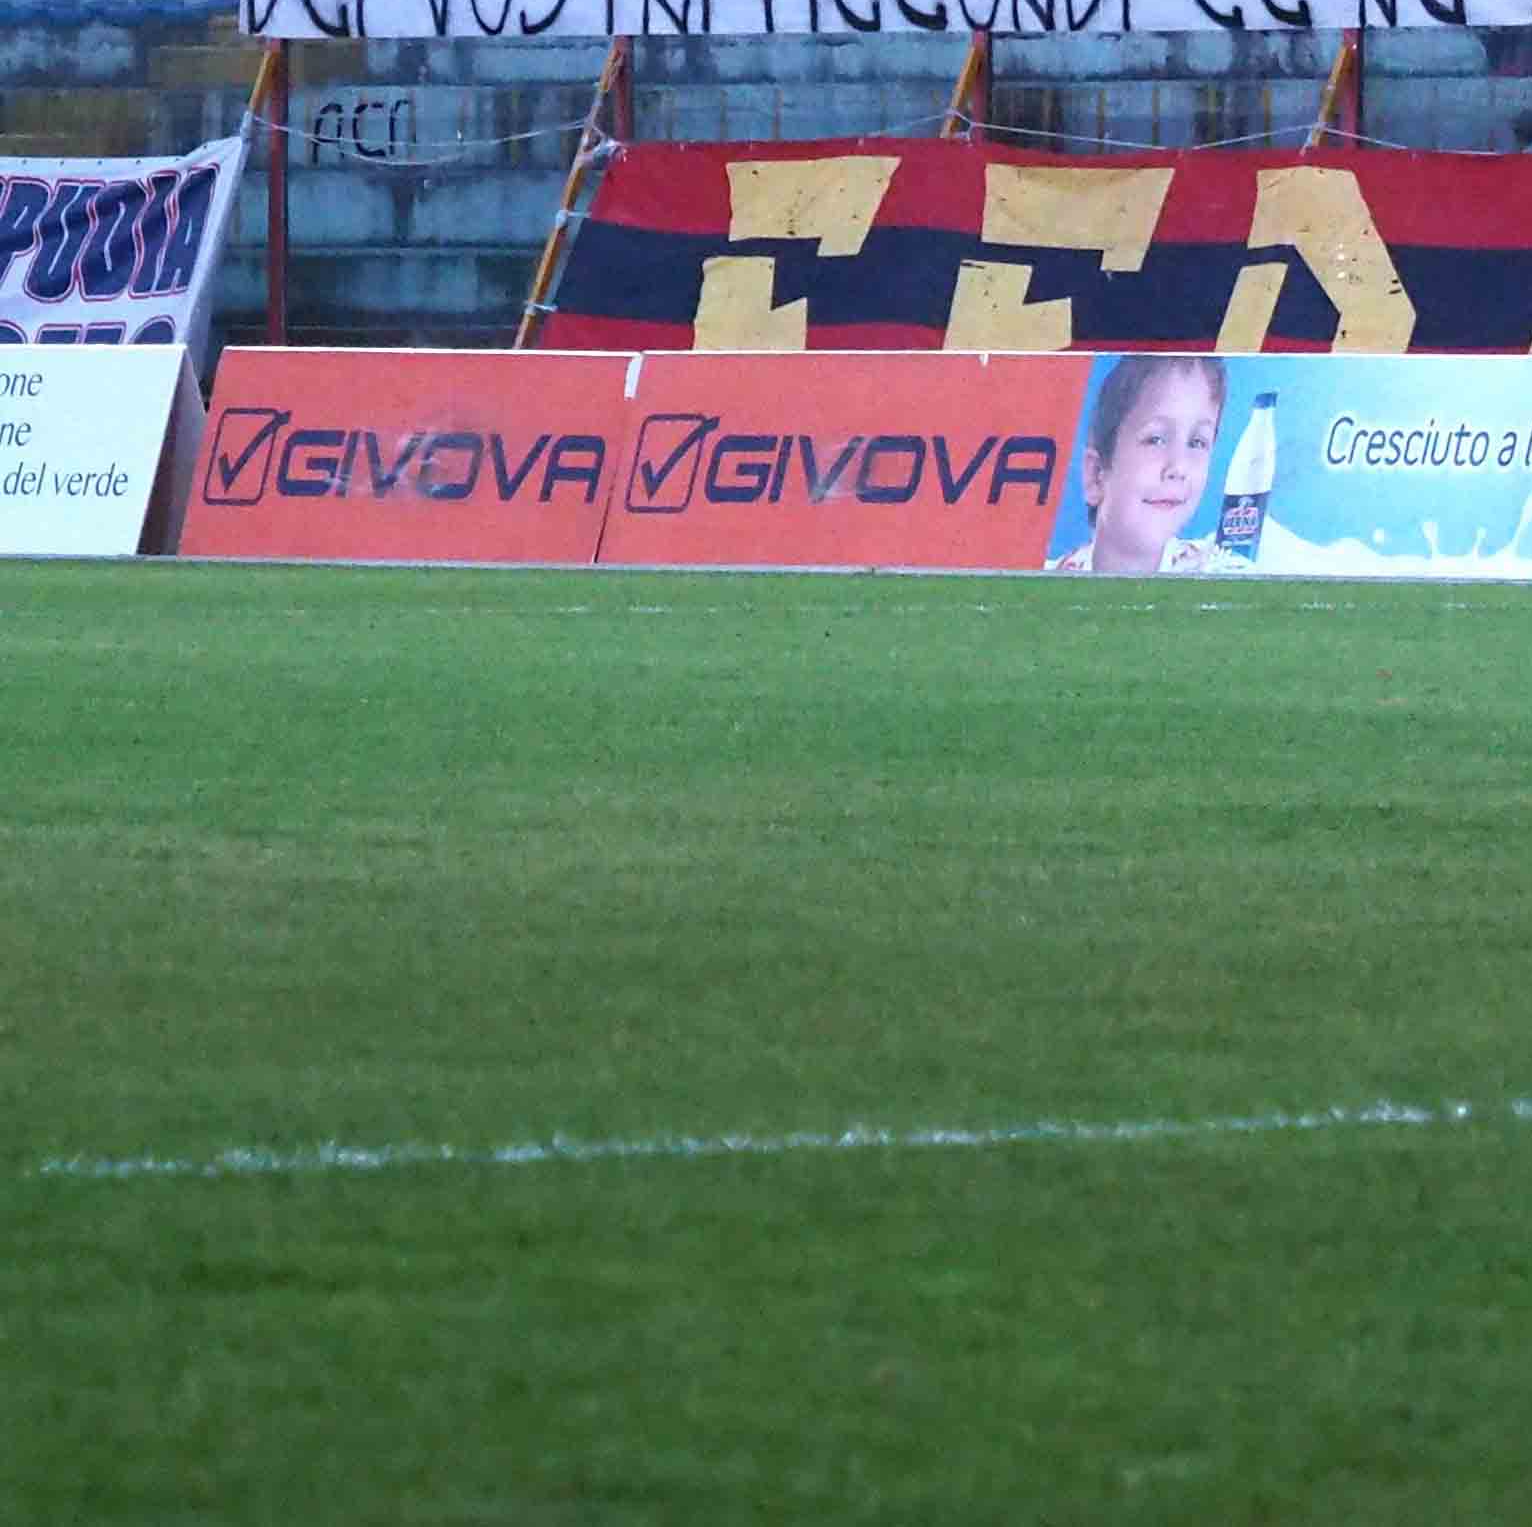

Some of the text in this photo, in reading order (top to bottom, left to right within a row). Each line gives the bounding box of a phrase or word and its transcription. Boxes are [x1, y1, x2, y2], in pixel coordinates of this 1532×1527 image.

[275, 429, 606, 503] GIVOVA
[704, 434, 1057, 506] GIVOVA
[1325, 416, 1490, 467] Cresciuto
[1497, 431, 1518, 467] a
[3, 461, 129, 497] del verde
